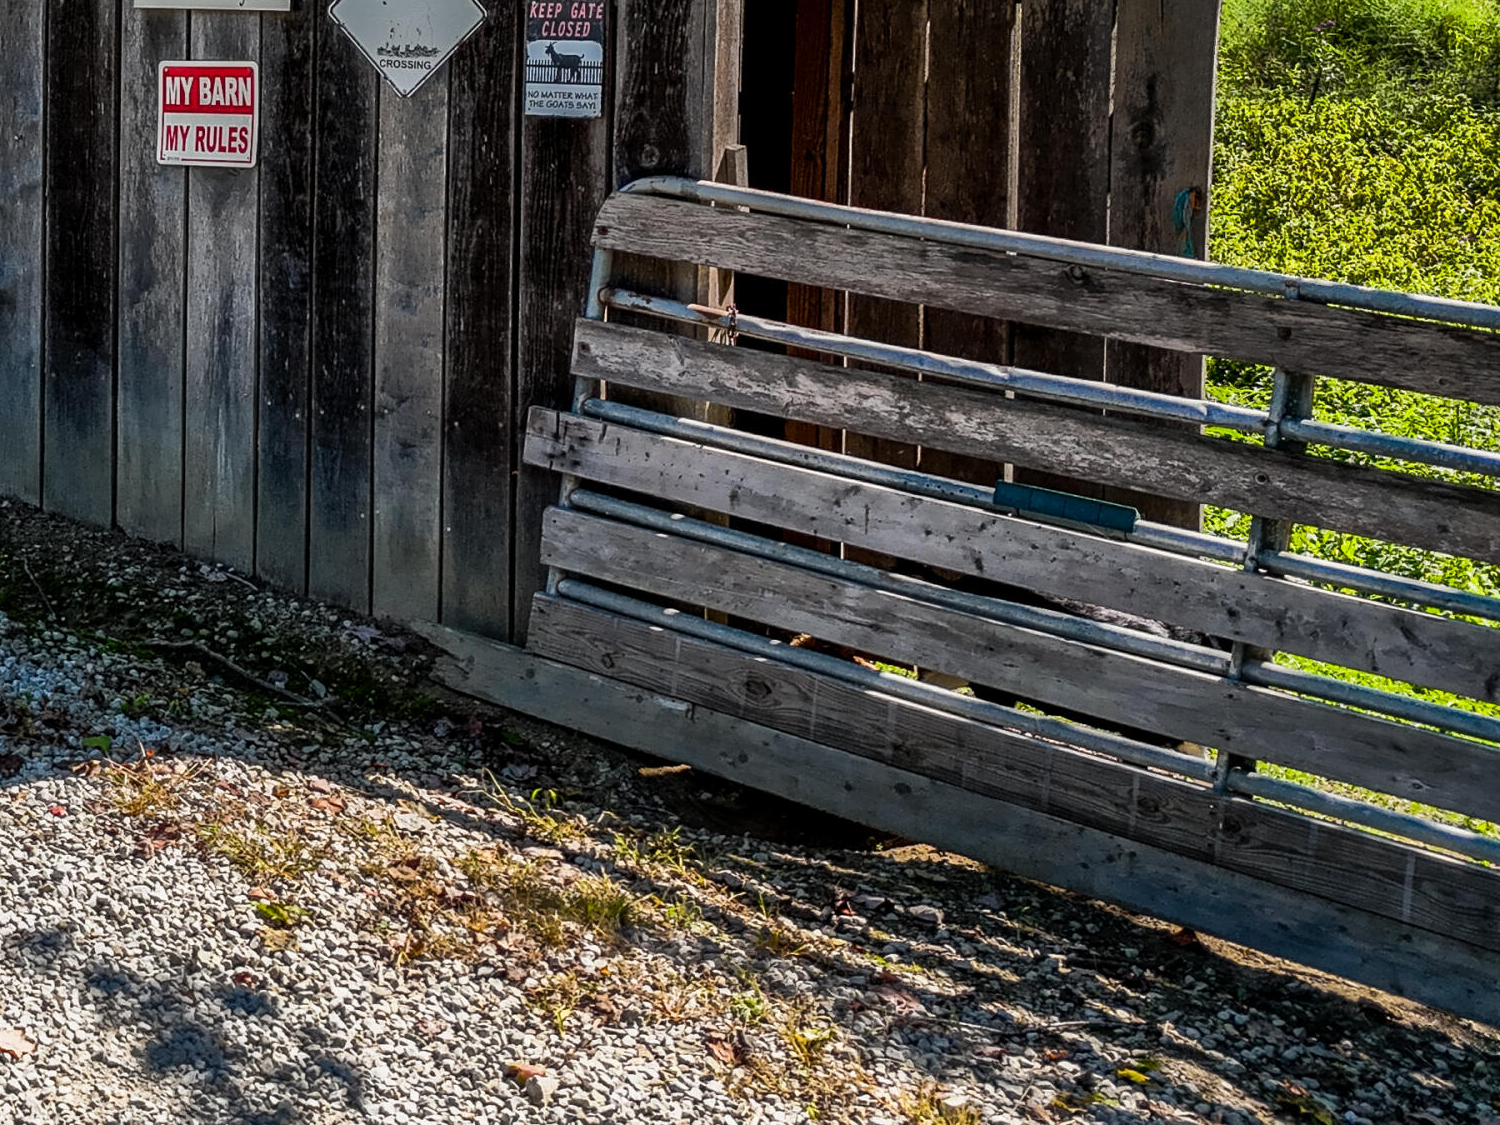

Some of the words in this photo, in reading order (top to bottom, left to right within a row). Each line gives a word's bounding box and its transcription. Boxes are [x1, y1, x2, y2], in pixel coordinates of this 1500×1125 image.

[529, 3, 562, 19] KEEP
[571, 2, 604, 19] GATE
[542, 21, 591, 37] CLOSED
[380, 59, 431, 70] CROSSING
[165, 76, 194, 105] MY
[199, 76, 252, 106] BARN
[541, 91, 573, 100] MATTER
[575, 92, 598, 100] WHAT
[529, 100, 544, 108] THE
[546, 100, 574, 109] GOATS
[576, 101, 596, 110] SAY!
[165, 125, 190, 151] MY
[195, 125, 248, 154] RULES
